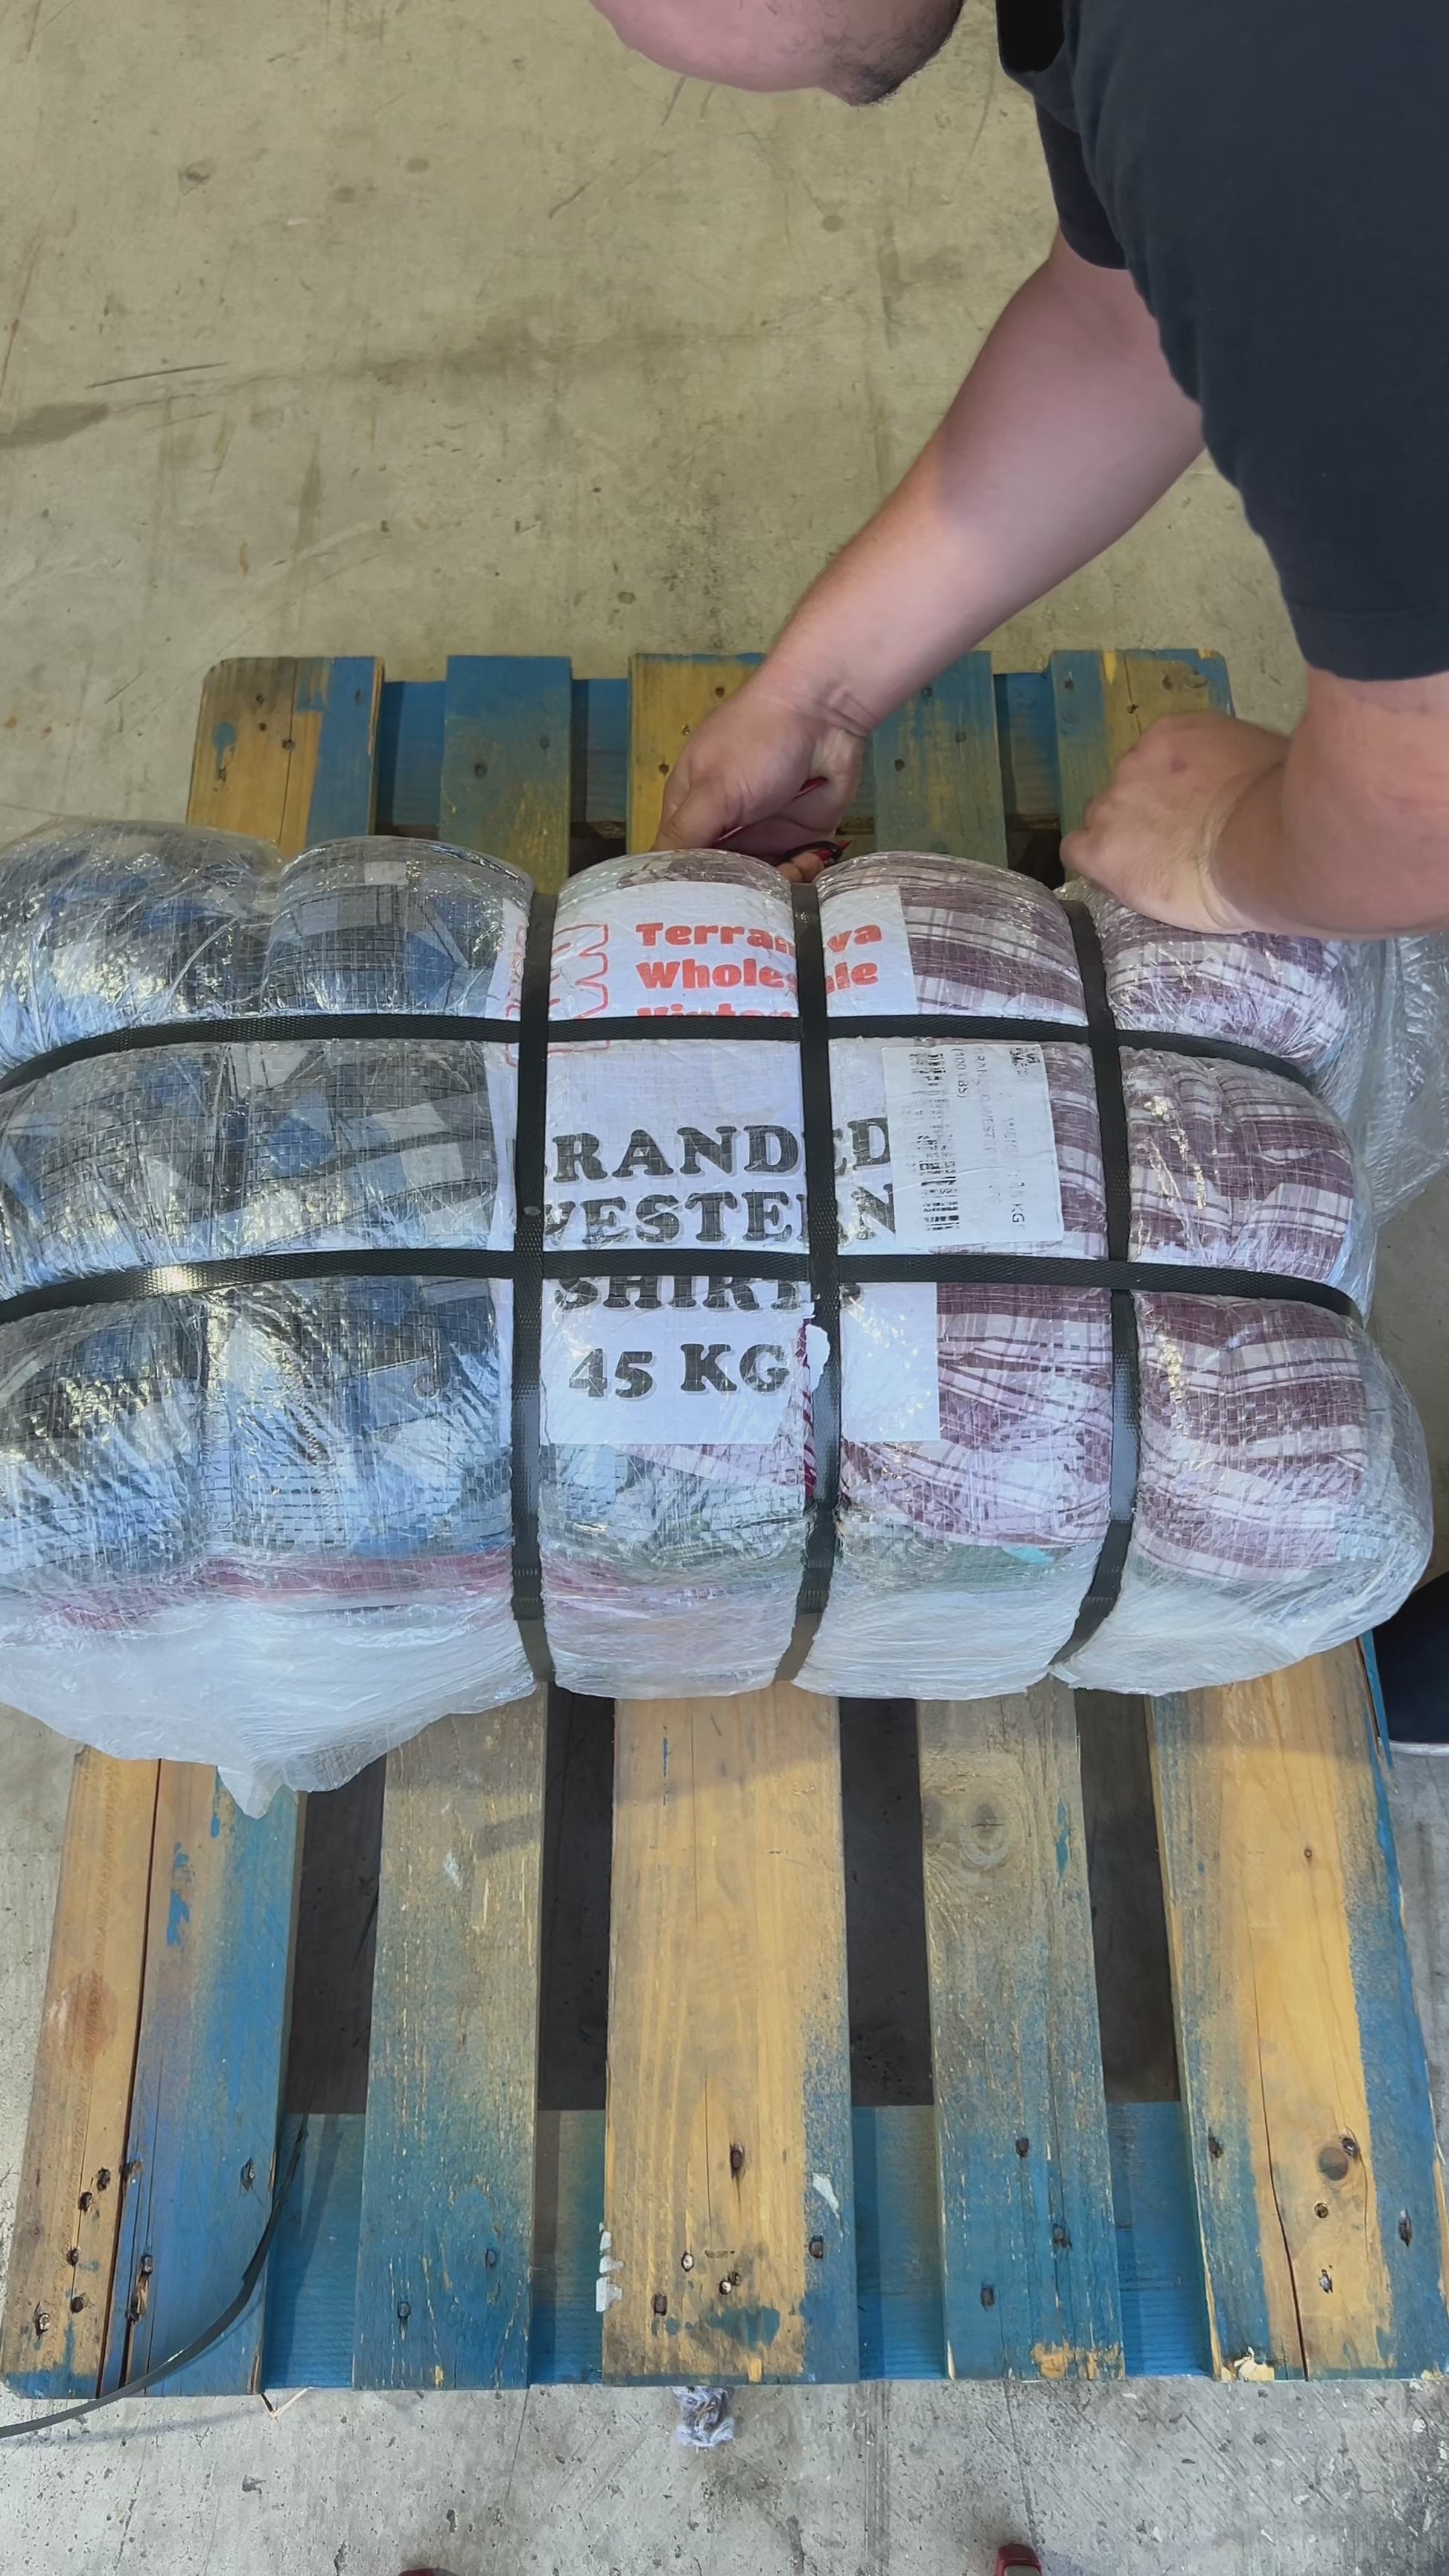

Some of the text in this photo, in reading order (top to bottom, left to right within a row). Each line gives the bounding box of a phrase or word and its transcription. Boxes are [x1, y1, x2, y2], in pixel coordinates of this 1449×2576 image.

[635, 922, 882, 957] Terranva
[568, 1343, 791, 1398] 45 KG
